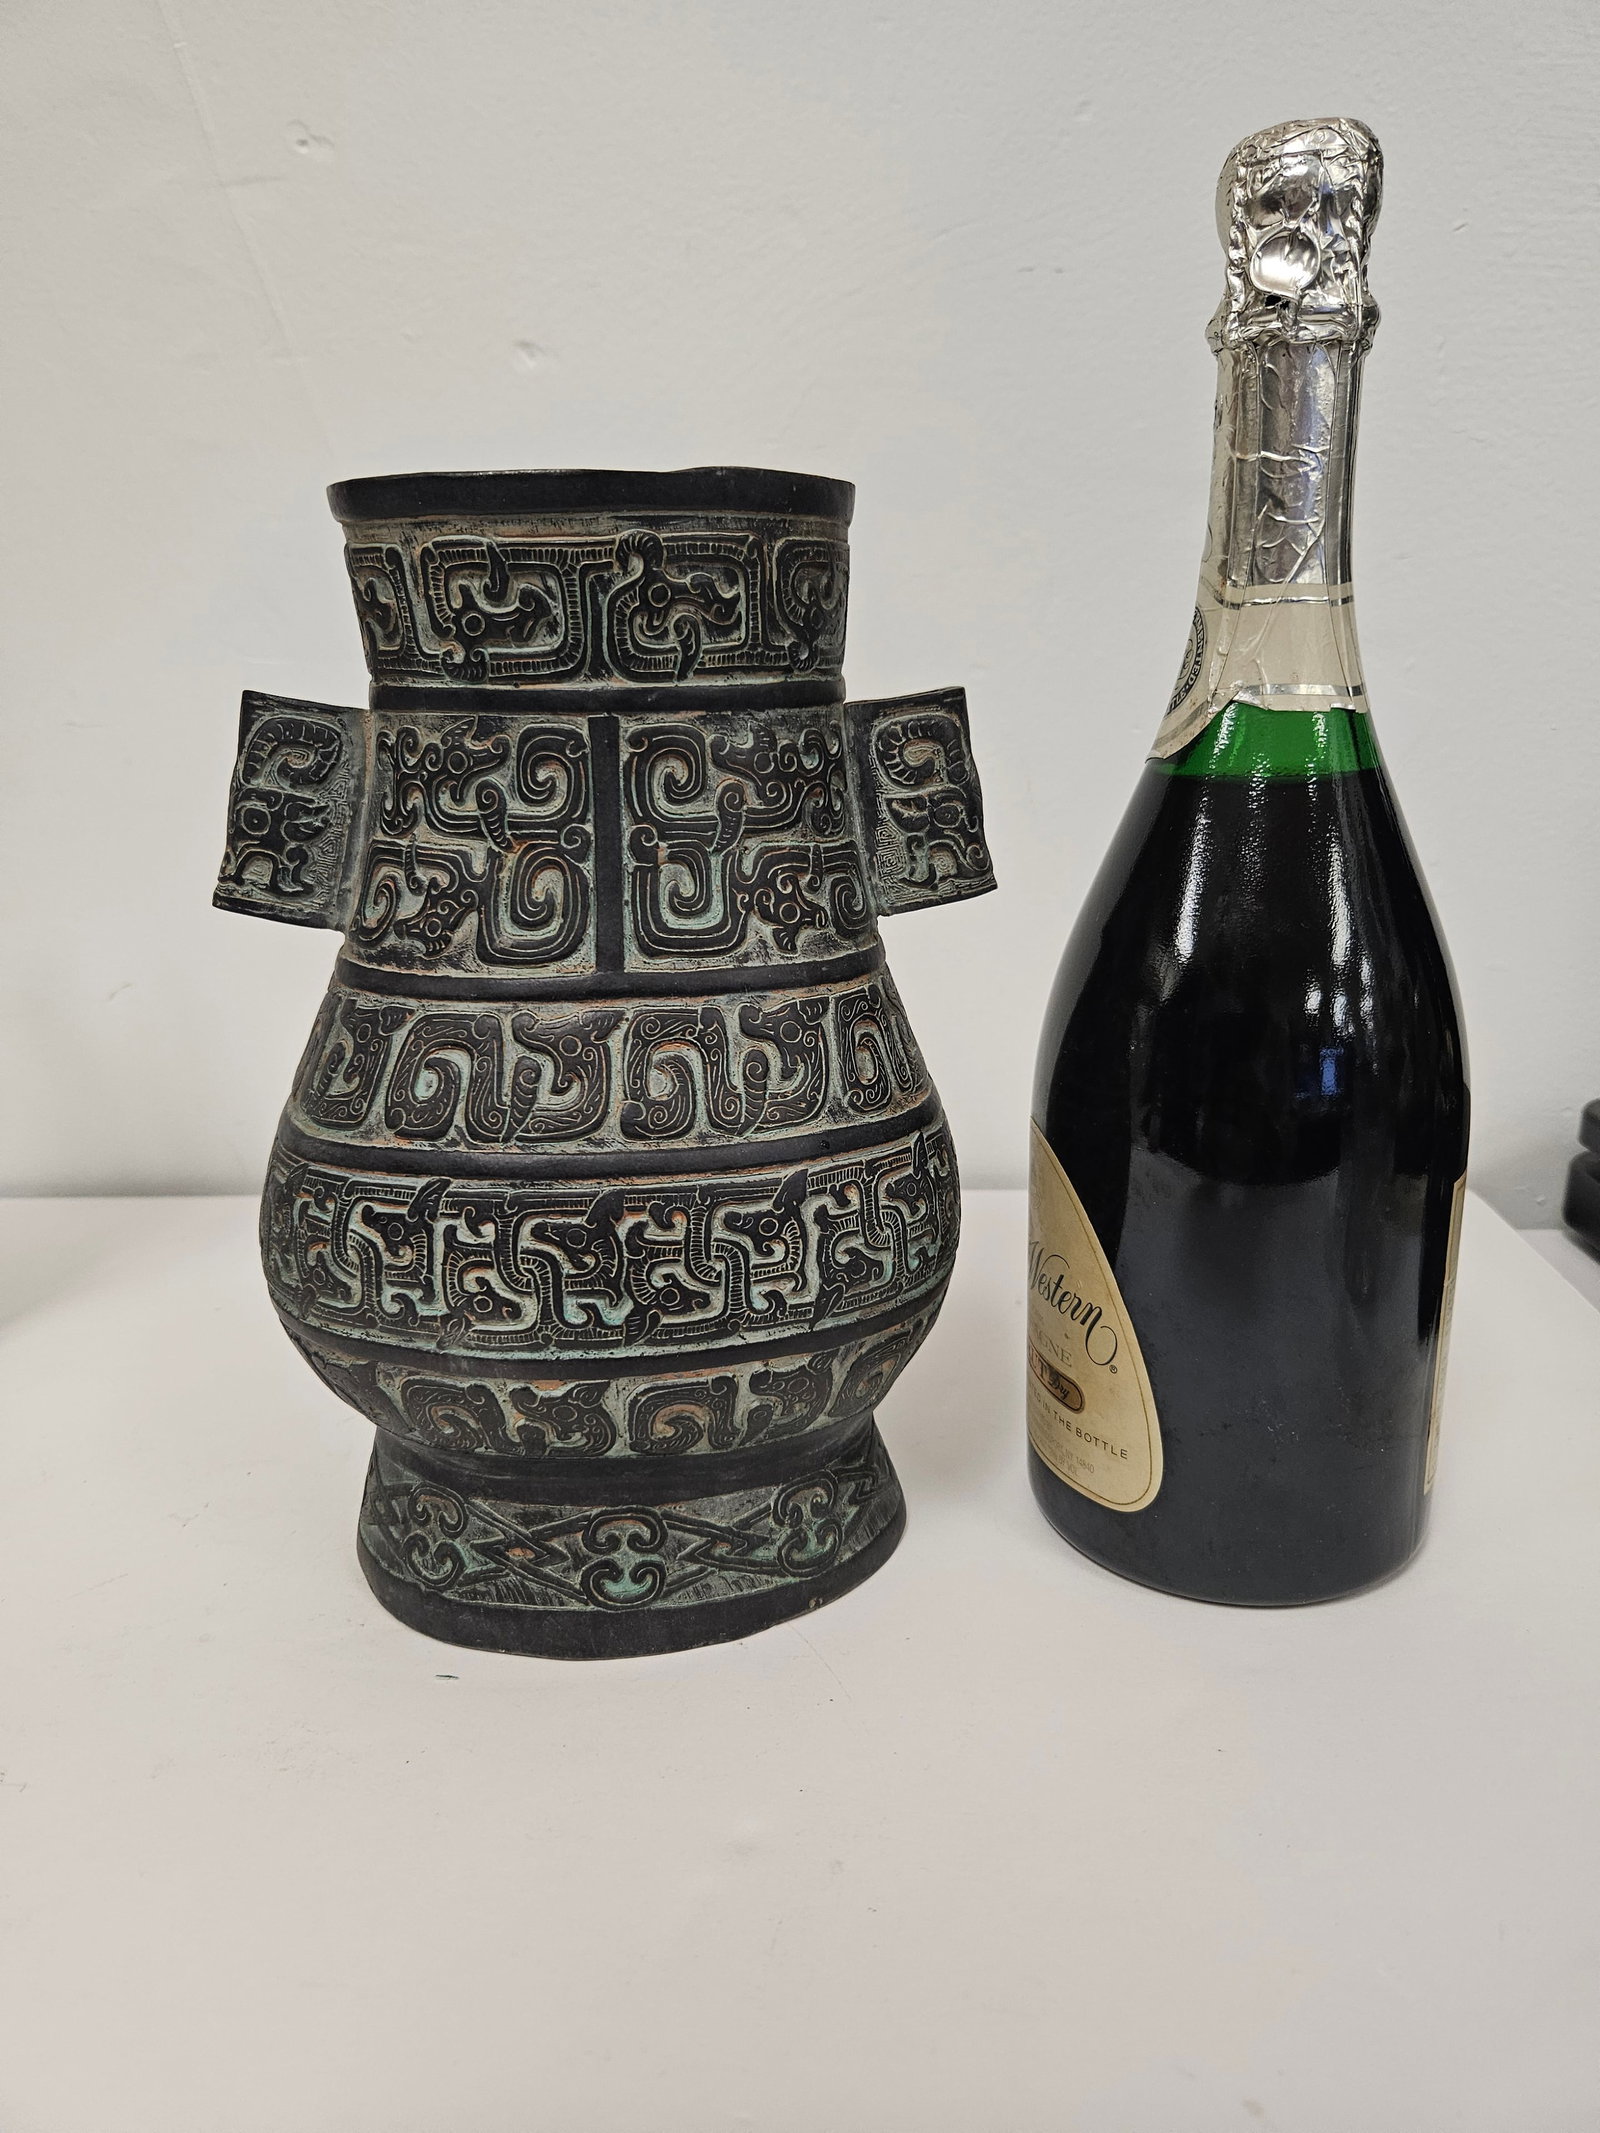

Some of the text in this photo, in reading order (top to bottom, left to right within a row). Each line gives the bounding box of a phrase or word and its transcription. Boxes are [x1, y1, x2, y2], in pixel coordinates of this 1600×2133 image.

[1028, 1240, 1118, 1366] Western
[1053, 1409, 1073, 1432] THE
[1075, 1426, 1129, 1460] BOTTLE
